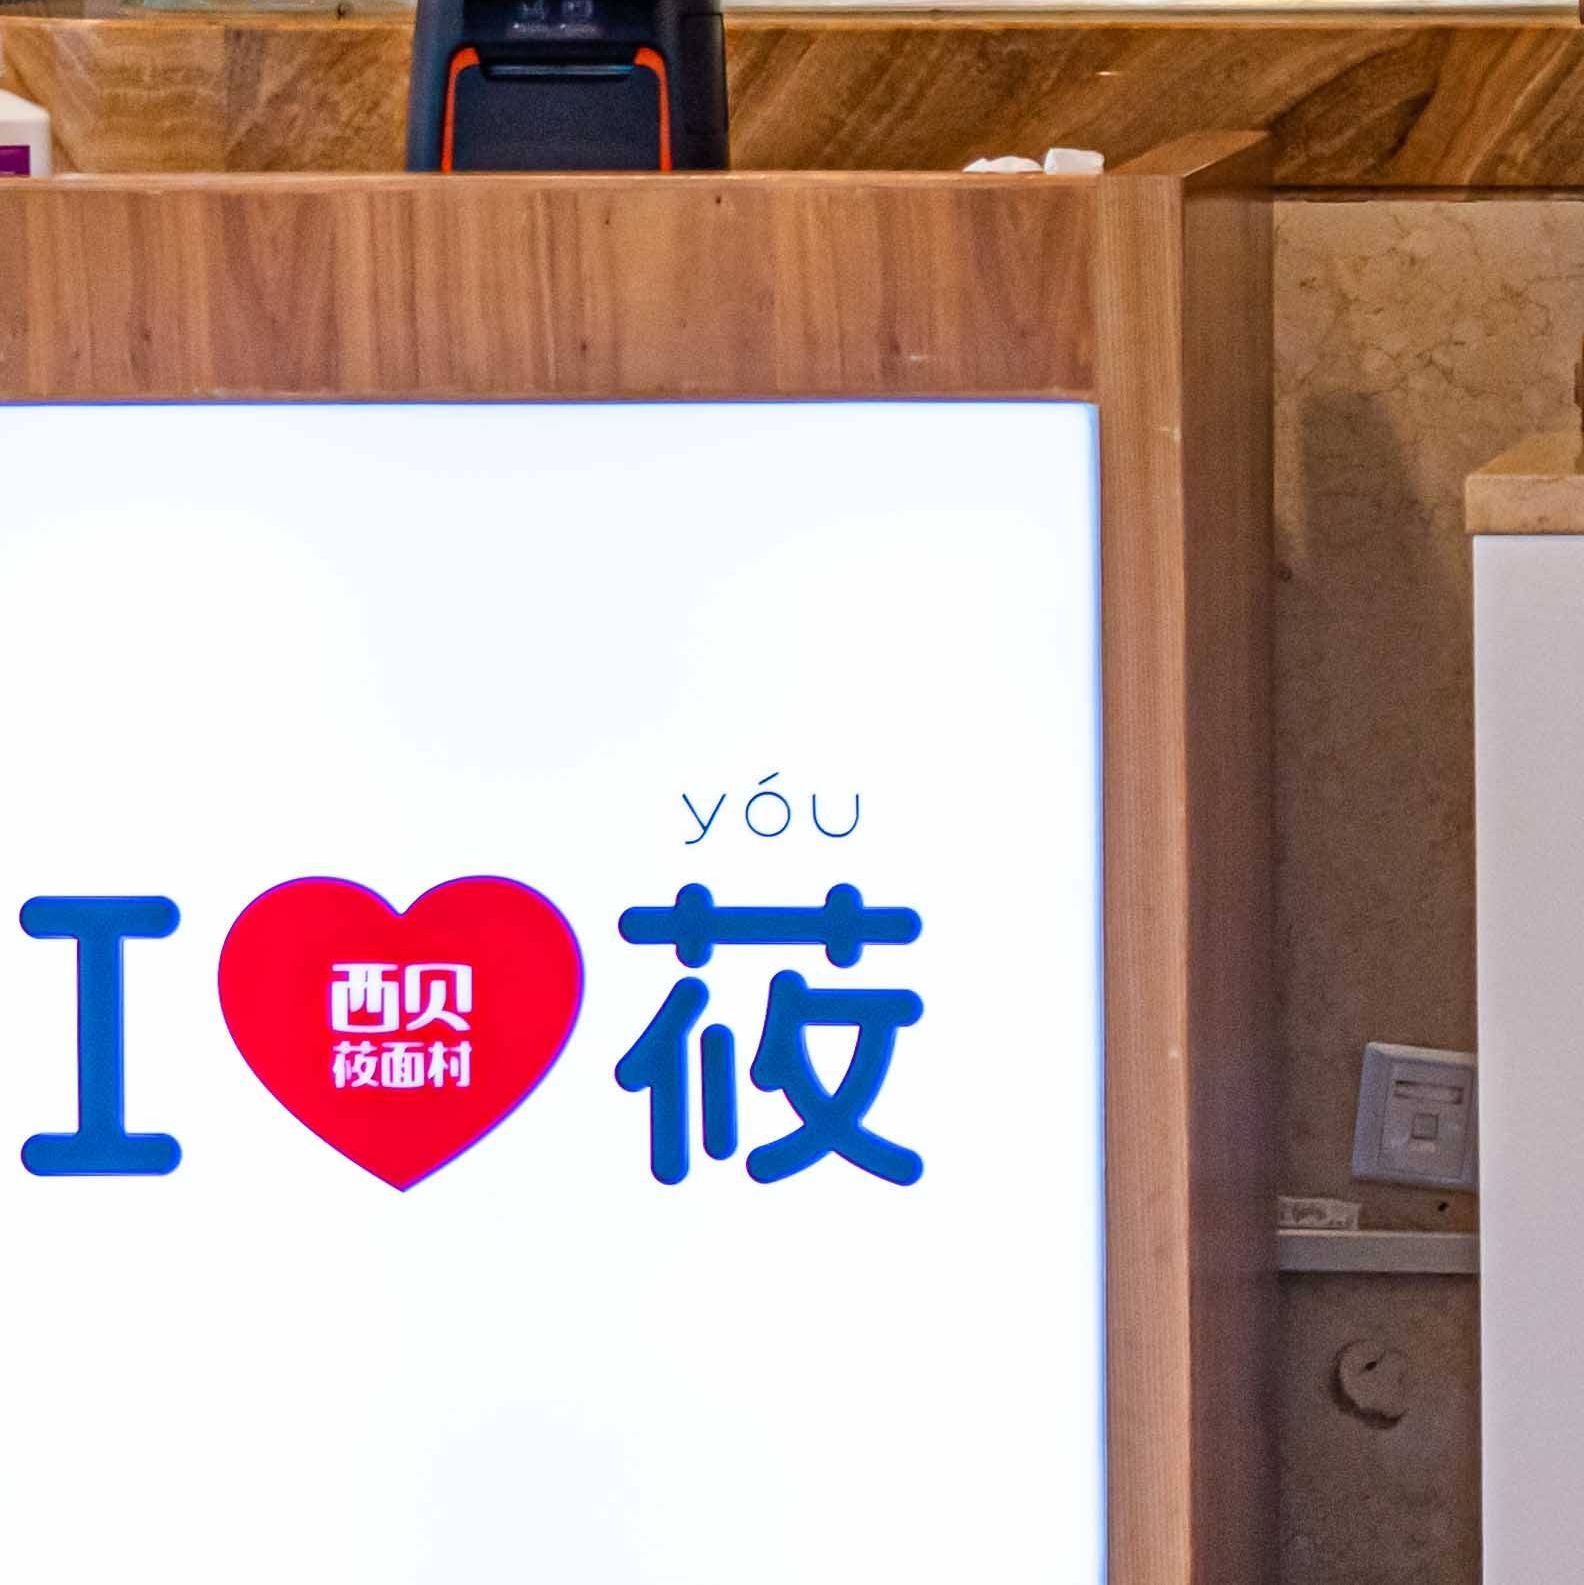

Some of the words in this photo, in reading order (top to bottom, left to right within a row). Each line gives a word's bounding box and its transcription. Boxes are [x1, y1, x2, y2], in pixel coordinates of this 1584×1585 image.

[681, 771, 861, 847] yóu
[18, 895, 183, 1177] I
[614, 881, 925, 1187] 莜
[330, 962, 473, 1034] 西贝
[330, 1039, 473, 1089] 莜面村
